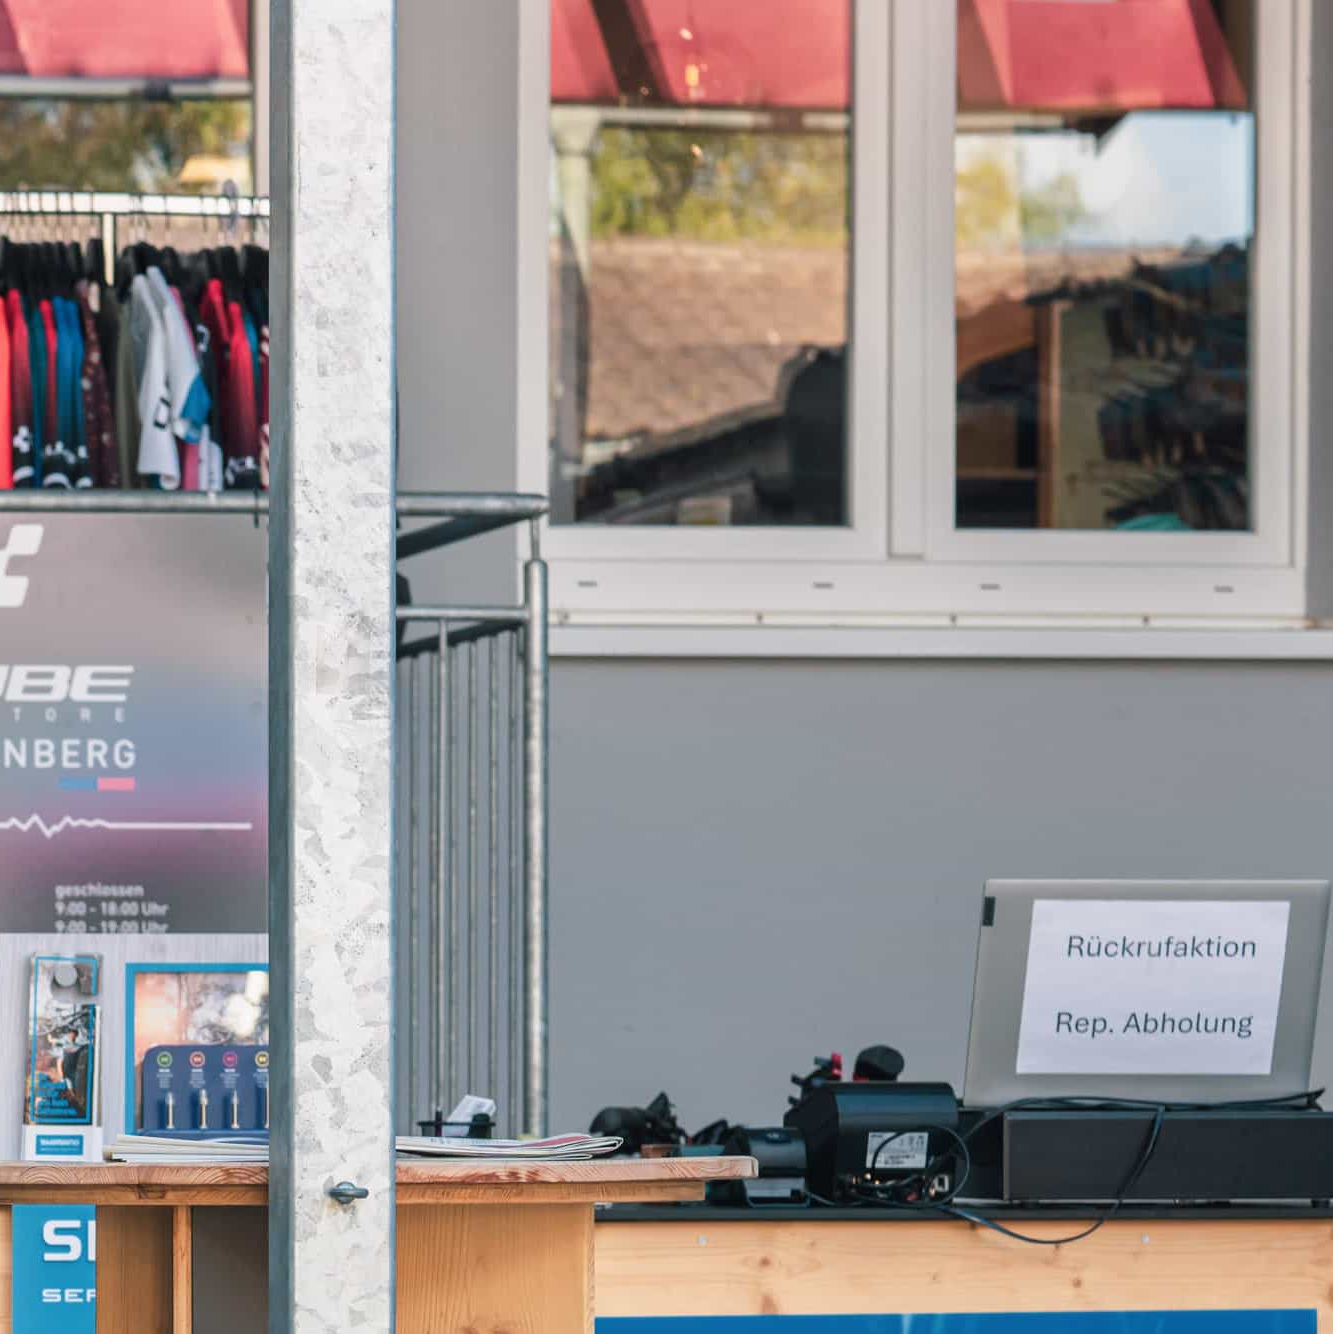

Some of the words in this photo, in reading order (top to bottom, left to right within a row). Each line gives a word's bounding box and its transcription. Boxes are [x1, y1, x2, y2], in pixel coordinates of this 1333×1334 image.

[1067, 935, 1257, 958] Rückrufaktion
[1056, 1011, 1114, 1039] Rep.
[1122, 1011, 1253, 1039] Abholung
[43, 1220, 96, 1262] S
